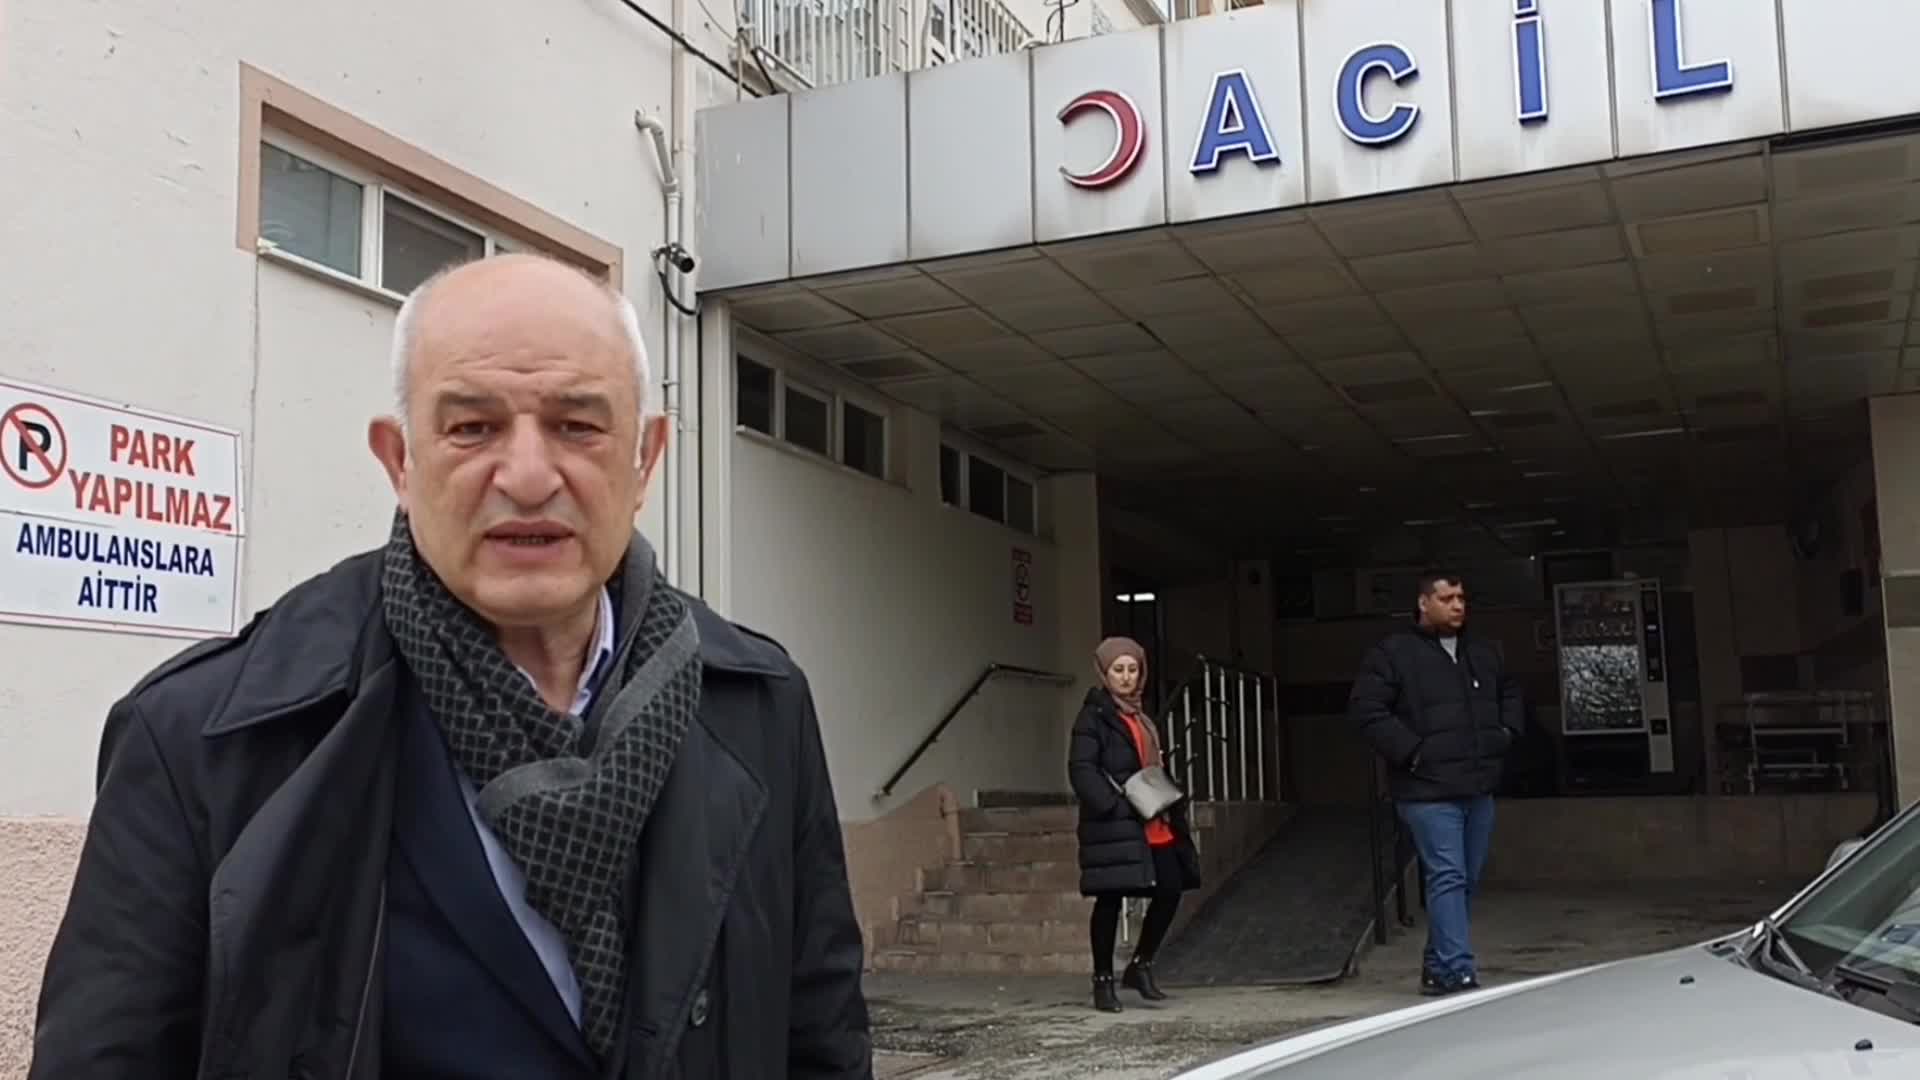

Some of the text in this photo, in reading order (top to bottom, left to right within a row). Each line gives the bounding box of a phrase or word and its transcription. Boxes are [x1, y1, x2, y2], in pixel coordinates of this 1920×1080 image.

[1190, 0, 1733, 176] ACİL
[110, 423, 195, 477] PARK
[67, 468, 232, 532] YAPILMAZ
[16, 522, 214, 577] AMBULANSLARA
[77, 570, 158, 614] AİTTİR
